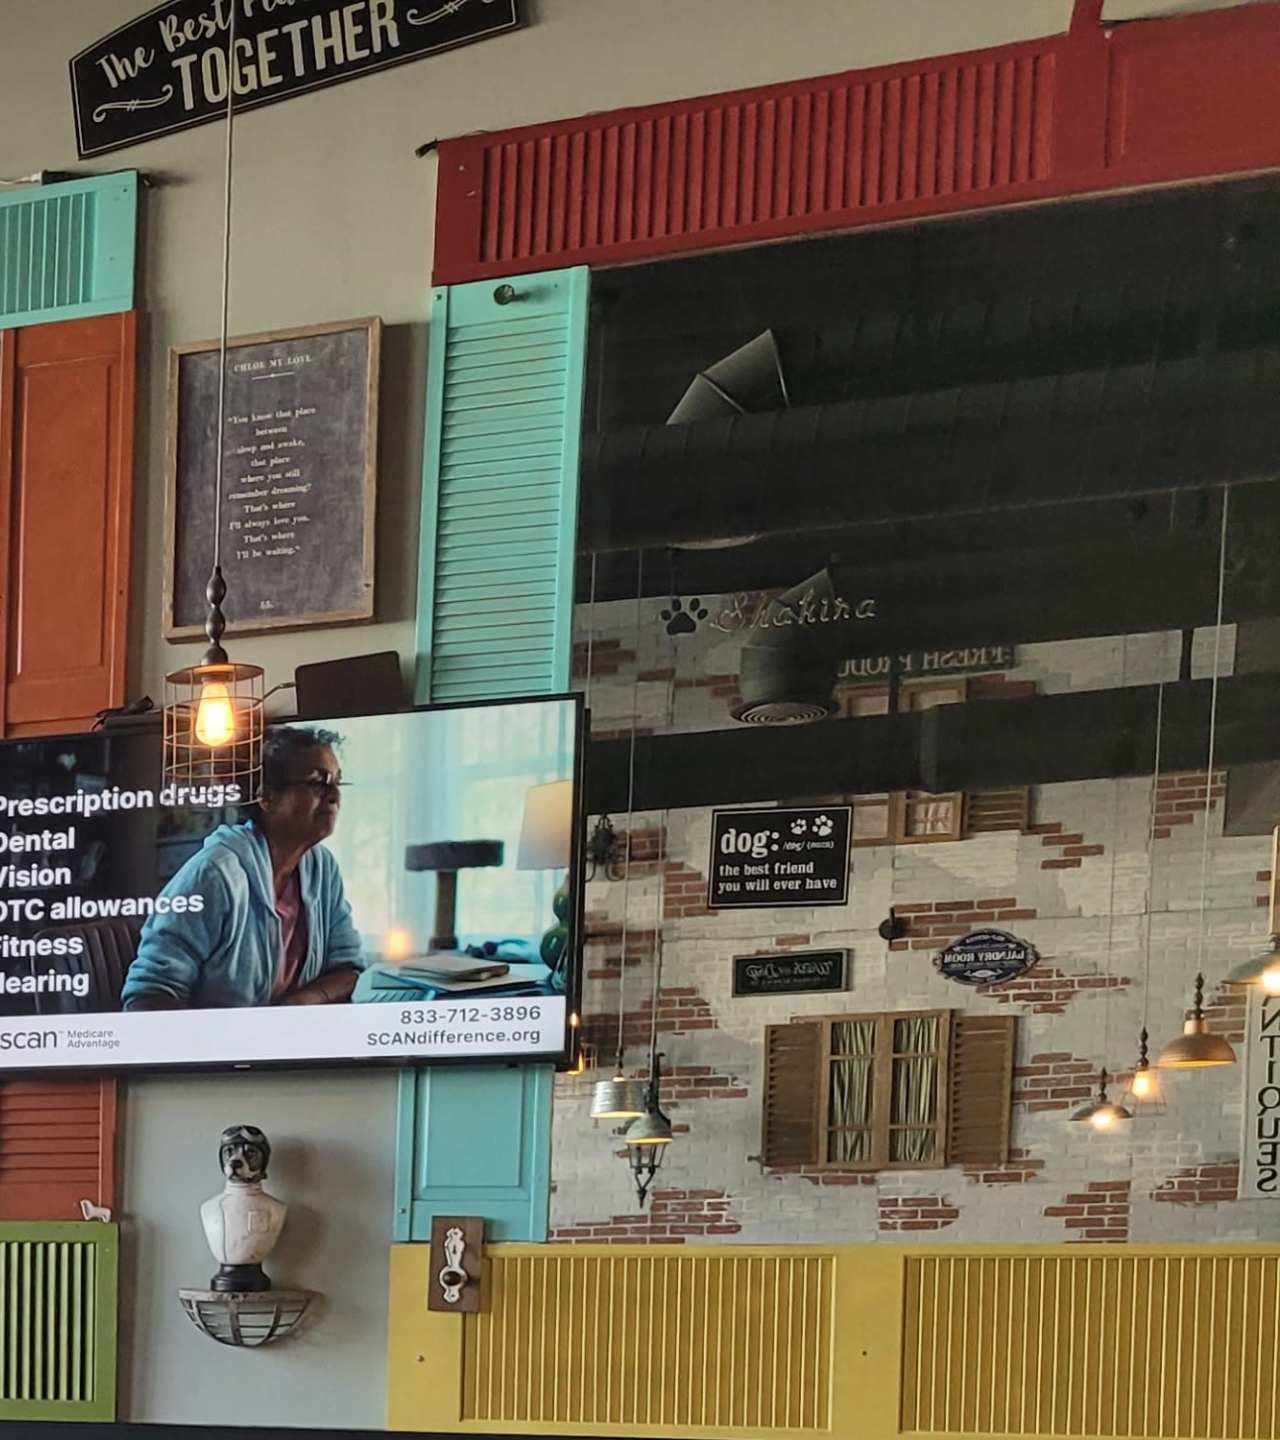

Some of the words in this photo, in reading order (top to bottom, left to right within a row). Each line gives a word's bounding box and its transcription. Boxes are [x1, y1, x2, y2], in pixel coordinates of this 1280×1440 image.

[95, 46, 155, 88] The
[158, 0, 232, 52] Best
[171, 0, 400, 111] TOGETHER
[159, 782, 241, 808] drugs
[720, 828, 780, 858] dog:
[720, 864, 740, 876] the
[744, 863, 769, 876] best
[774, 861, 814, 874] friend
[718, 881, 740, 894] you
[745, 879, 770, 891] will
[773, 880, 801, 890] ever
[805, 878, 837, 890] have
[50, 893, 204, 920] allowances
[400, 1006, 541, 1025] 833-712-3896
[0, 1030, 57, 1050] scan
[67, 1029, 114, 1039] Medicare
[67, 1038, 120, 1049] Advantage
[367, 1029, 541, 1046] SCANdifference.org
